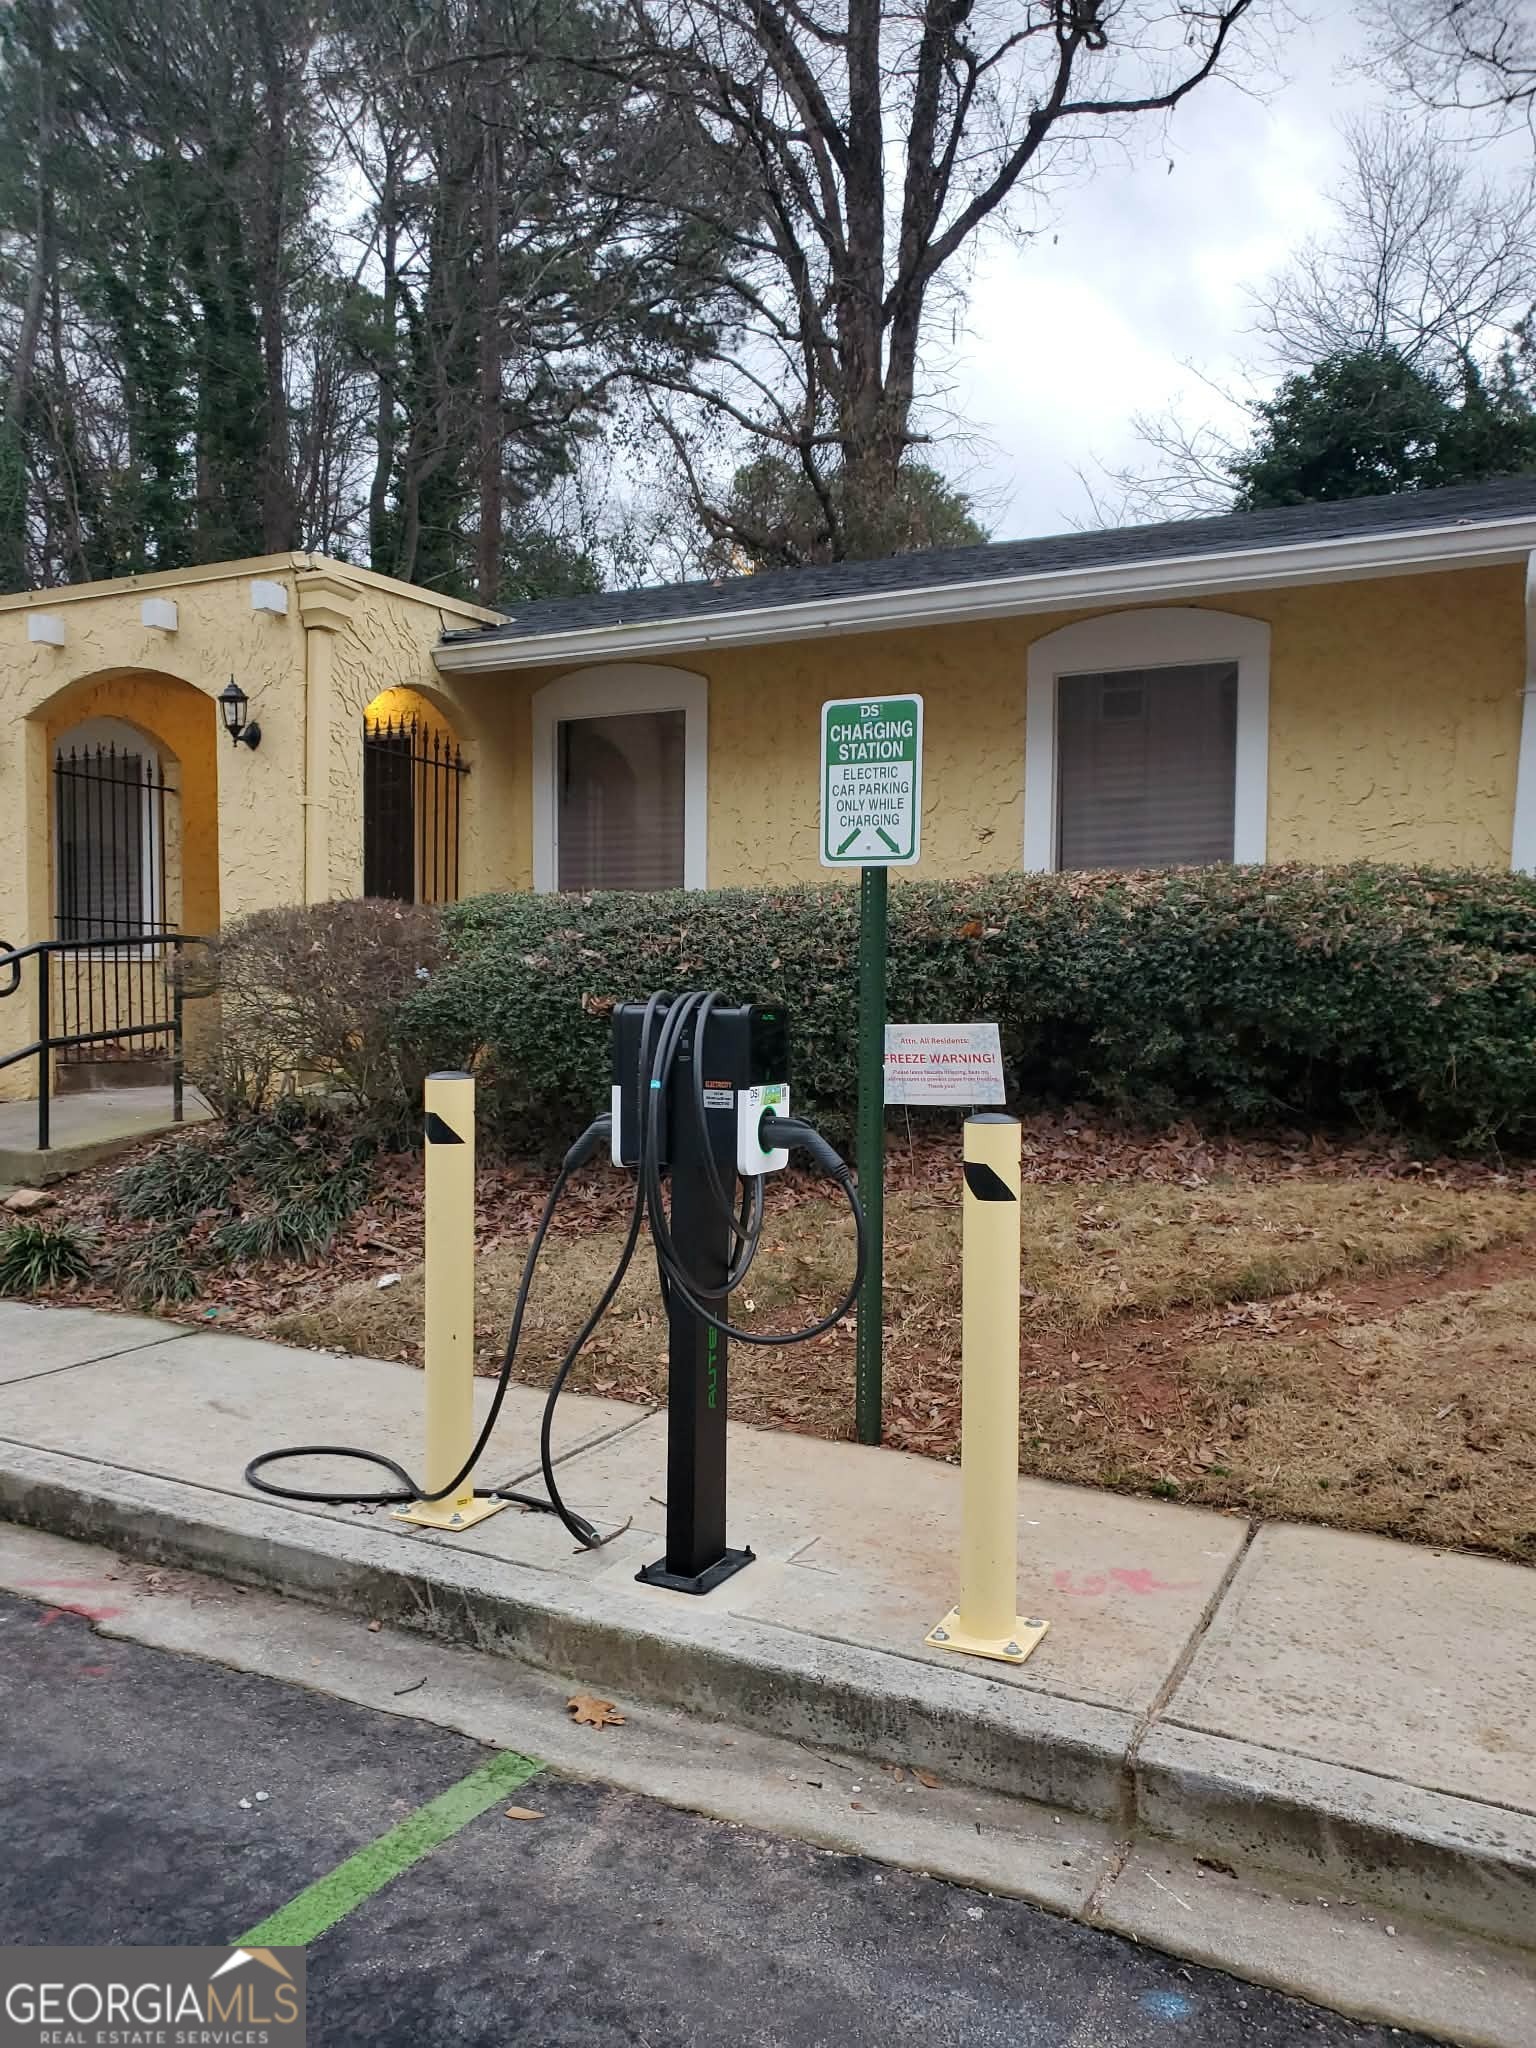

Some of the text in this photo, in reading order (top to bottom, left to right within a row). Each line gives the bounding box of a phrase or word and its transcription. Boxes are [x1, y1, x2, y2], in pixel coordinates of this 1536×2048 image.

[830, 720, 913, 742] CHARGING
[838, 741, 904, 760] STATION
[843, 766, 898, 781] ELECTRIC
[832, 781, 909, 796] CAR PARKING
[836, 797, 904, 812] ONLY WHILE
[840, 814, 900, 827] CHARGING
[884, 1053, 995, 1064] FREEZE WARNING!
